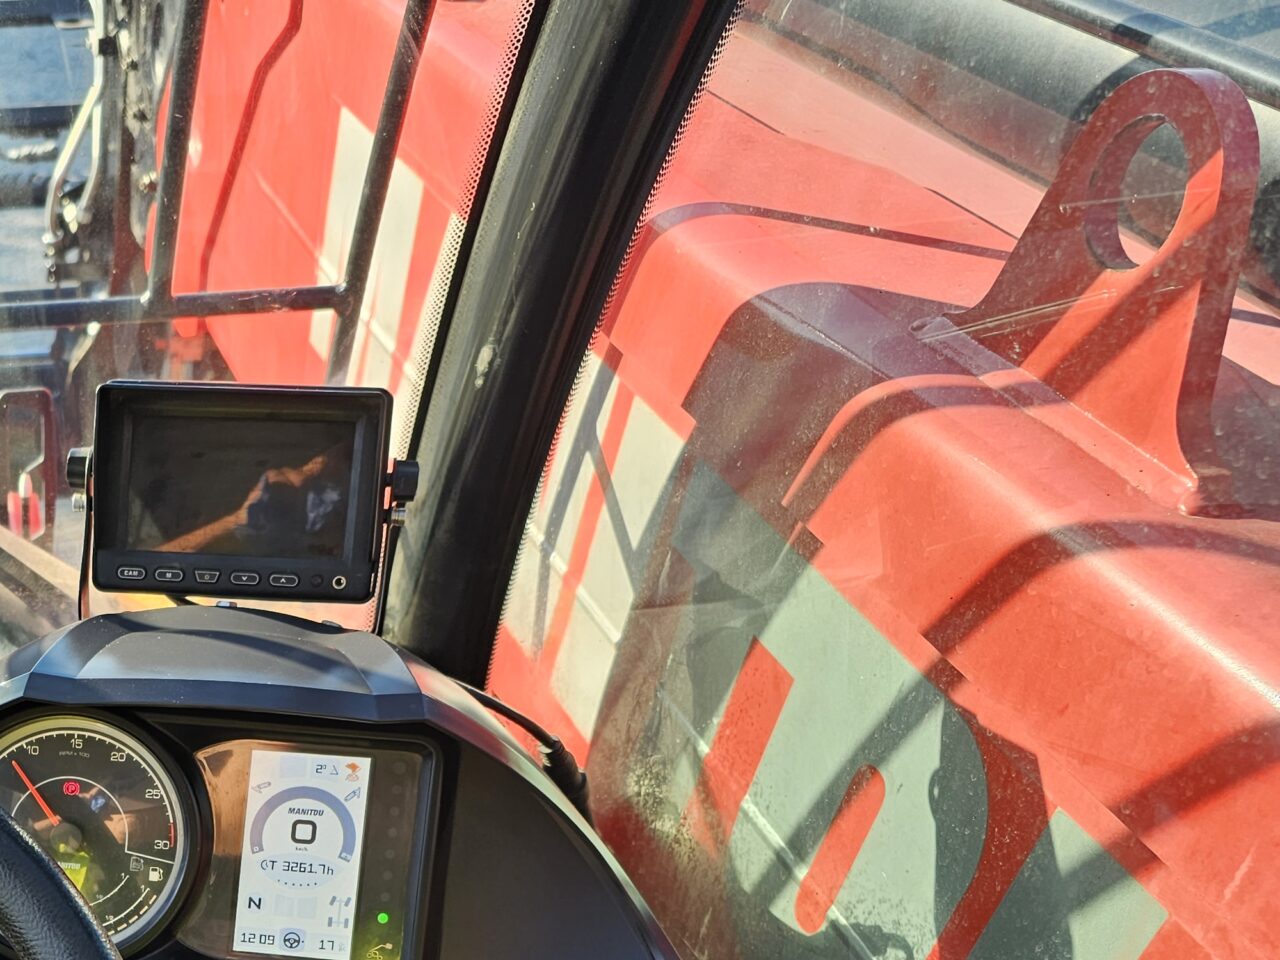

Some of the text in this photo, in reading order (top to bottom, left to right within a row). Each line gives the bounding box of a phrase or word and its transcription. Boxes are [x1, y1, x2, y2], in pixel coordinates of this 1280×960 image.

[70, 739, 83, 749] 15
[26, 745, 39, 755] 10
[110, 752, 126, 762] 20
[145, 789, 161, 799] 25
[287, 807, 324, 817] MANITOU
[291, 819, 317, 845] 0
[154, 840, 170, 850] 30
[248, 896, 262, 910] N
[319, 940, 335, 951] 17
